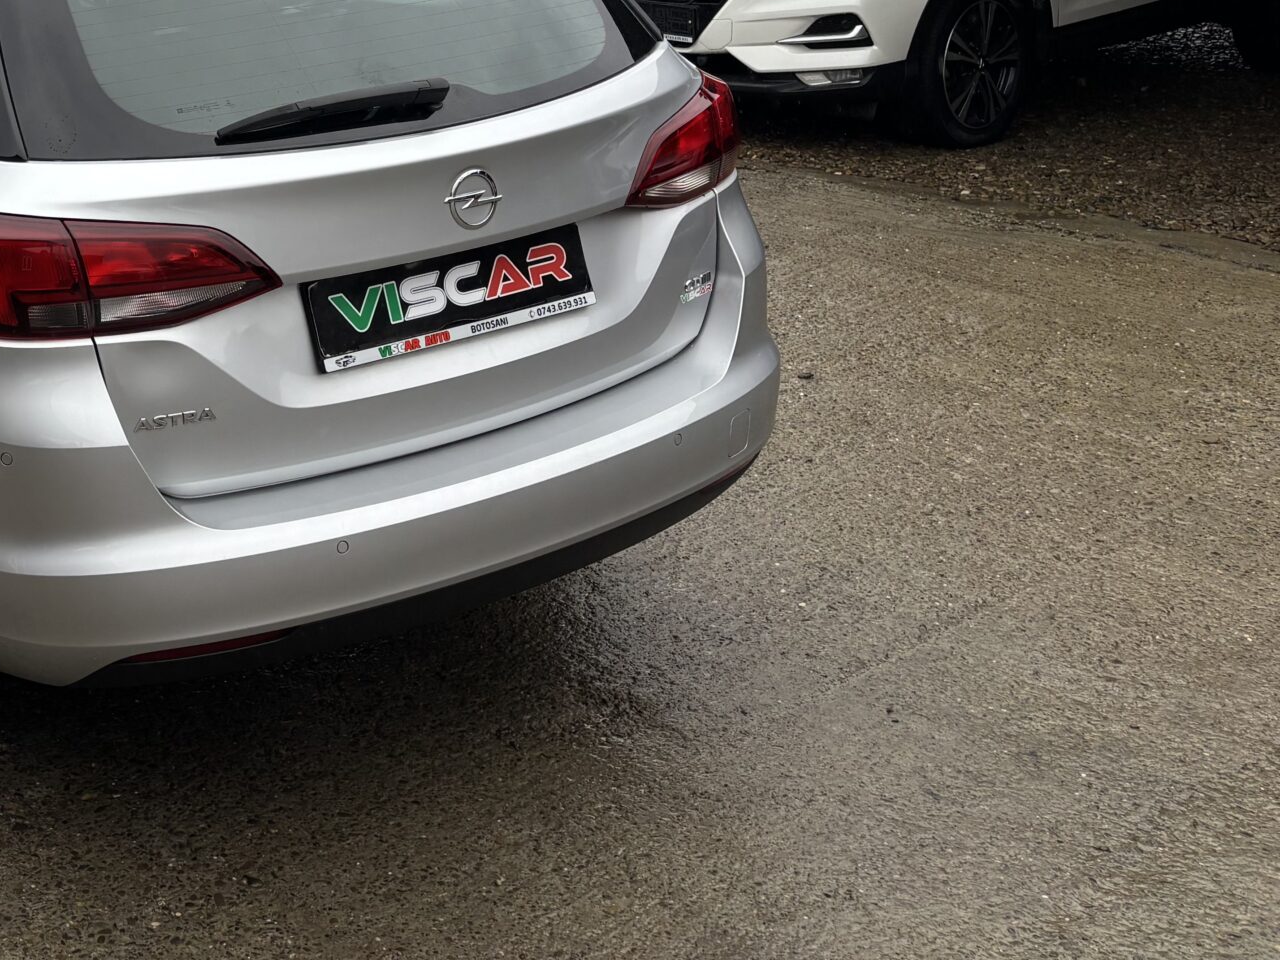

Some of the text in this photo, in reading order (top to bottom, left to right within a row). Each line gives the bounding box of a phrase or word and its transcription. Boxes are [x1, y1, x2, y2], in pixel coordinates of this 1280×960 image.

[327, 242, 573, 333] VISCAR
[679, 282, 713, 304] VISCAR
[378, 296, 588, 359] VISCAR AUTO BOTOSANI 0743.639.931
[133, 407, 217, 433] ASTRA
